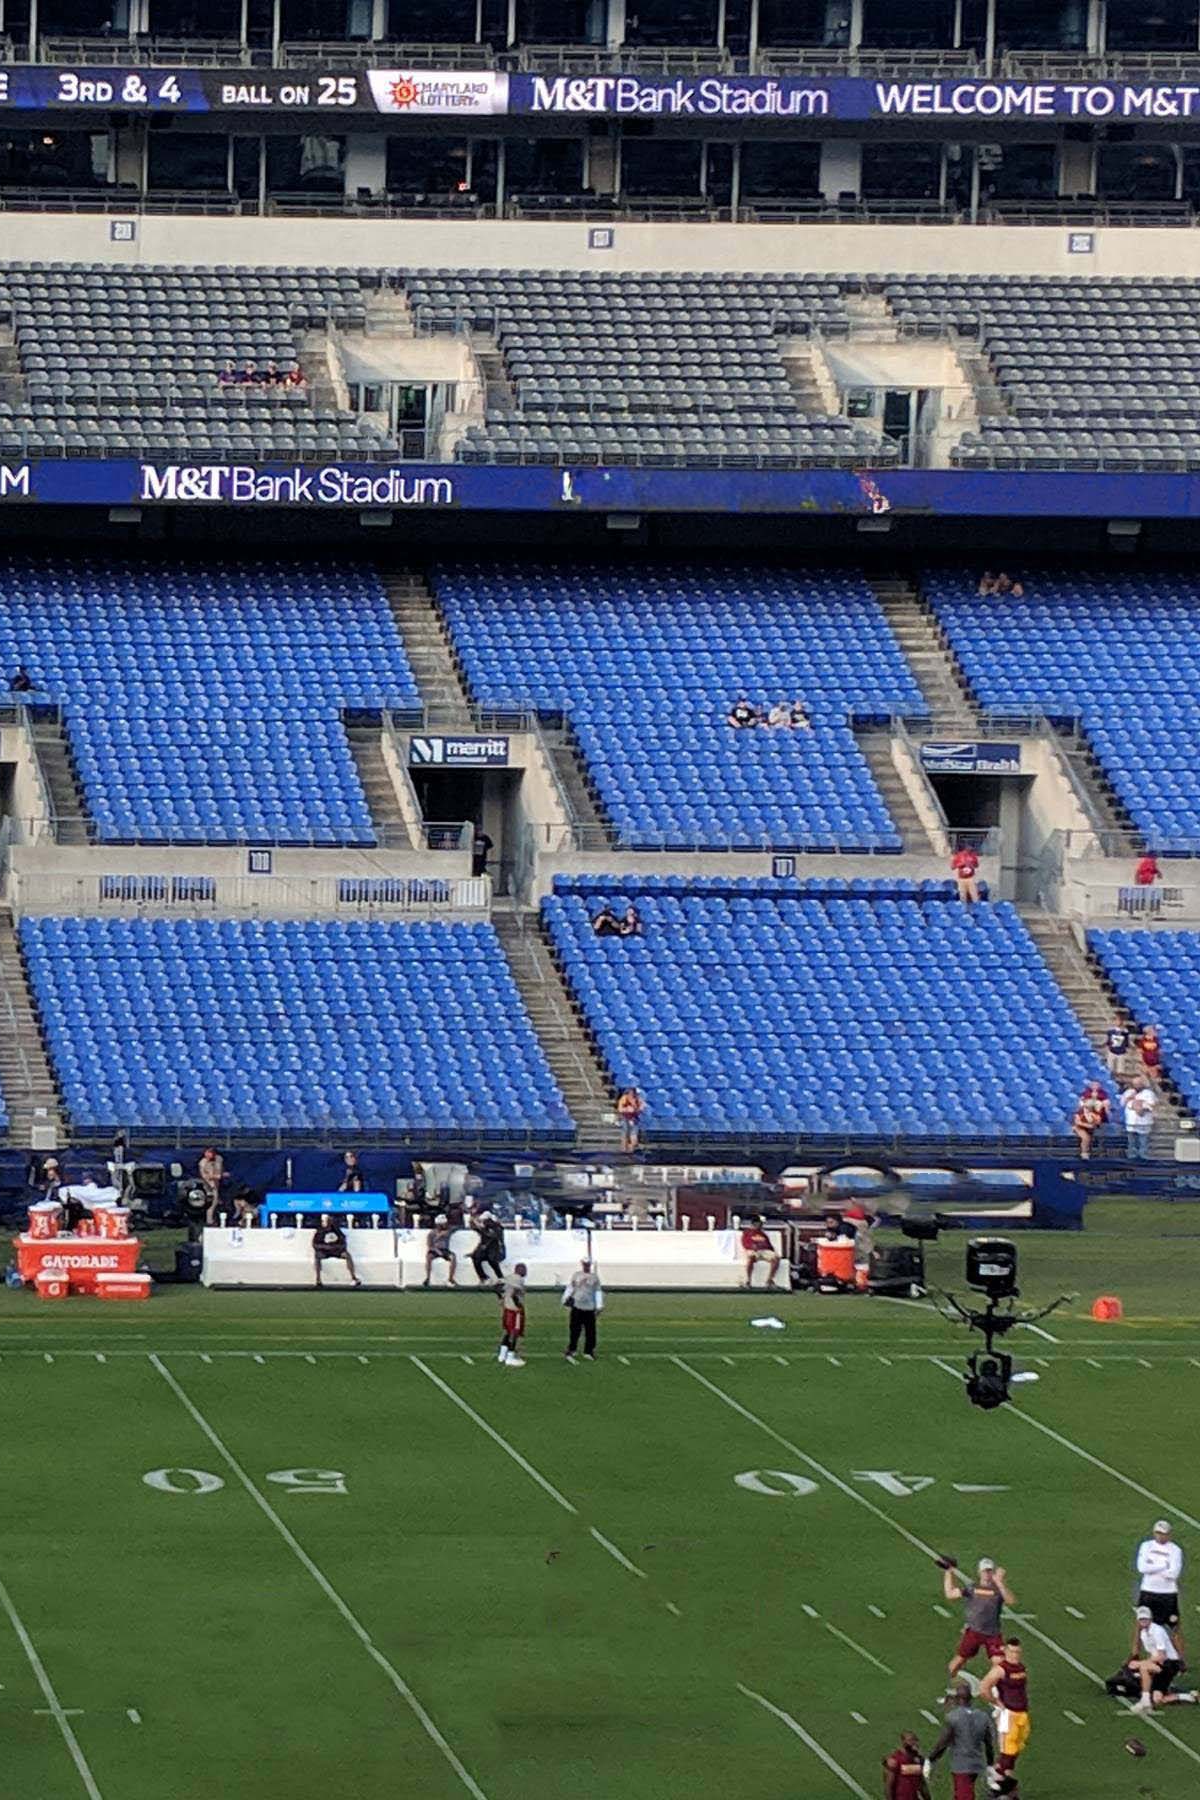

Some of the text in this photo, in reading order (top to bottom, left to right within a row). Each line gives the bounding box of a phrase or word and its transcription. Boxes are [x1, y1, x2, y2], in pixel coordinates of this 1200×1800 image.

[58, 73, 181, 103] 3RD & 4
[222, 77, 357, 105] BALL ON 25
[531, 77, 830, 114] M&T Bank Stadium
[875, 83, 1200, 117] WELCOME TO M&T
[140, 464, 452, 504] M&T Bank Stadium
[40, 1254, 119, 1268] GATORADE
